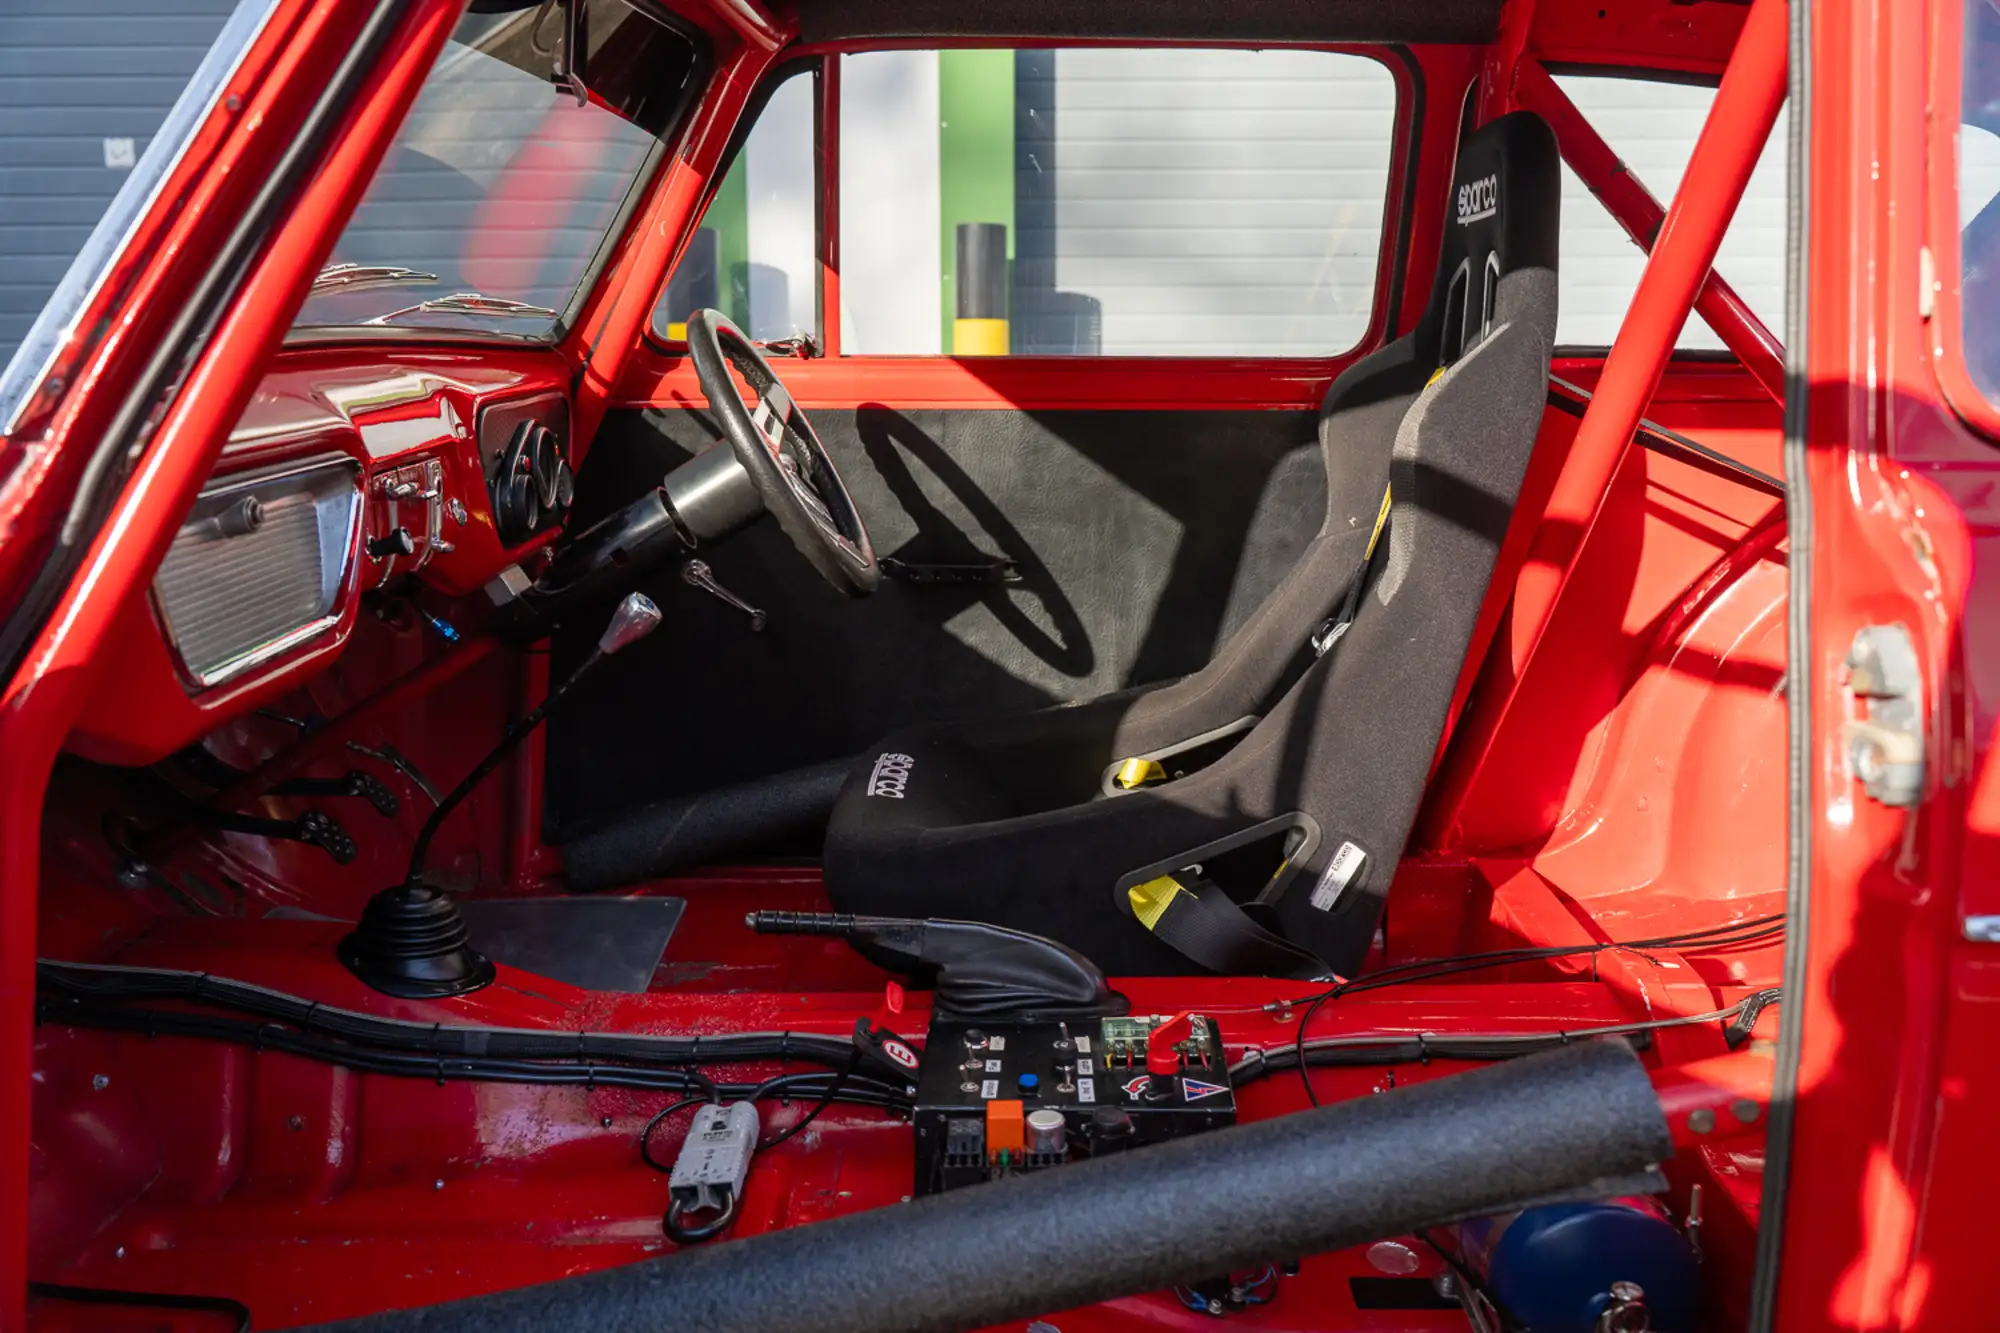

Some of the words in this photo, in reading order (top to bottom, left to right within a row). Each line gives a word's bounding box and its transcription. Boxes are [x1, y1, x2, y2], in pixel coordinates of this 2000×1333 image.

[1458, 173, 1497, 227] sparco
[870, 753, 915, 799] sparco
[889, 1044, 912, 1064] E
